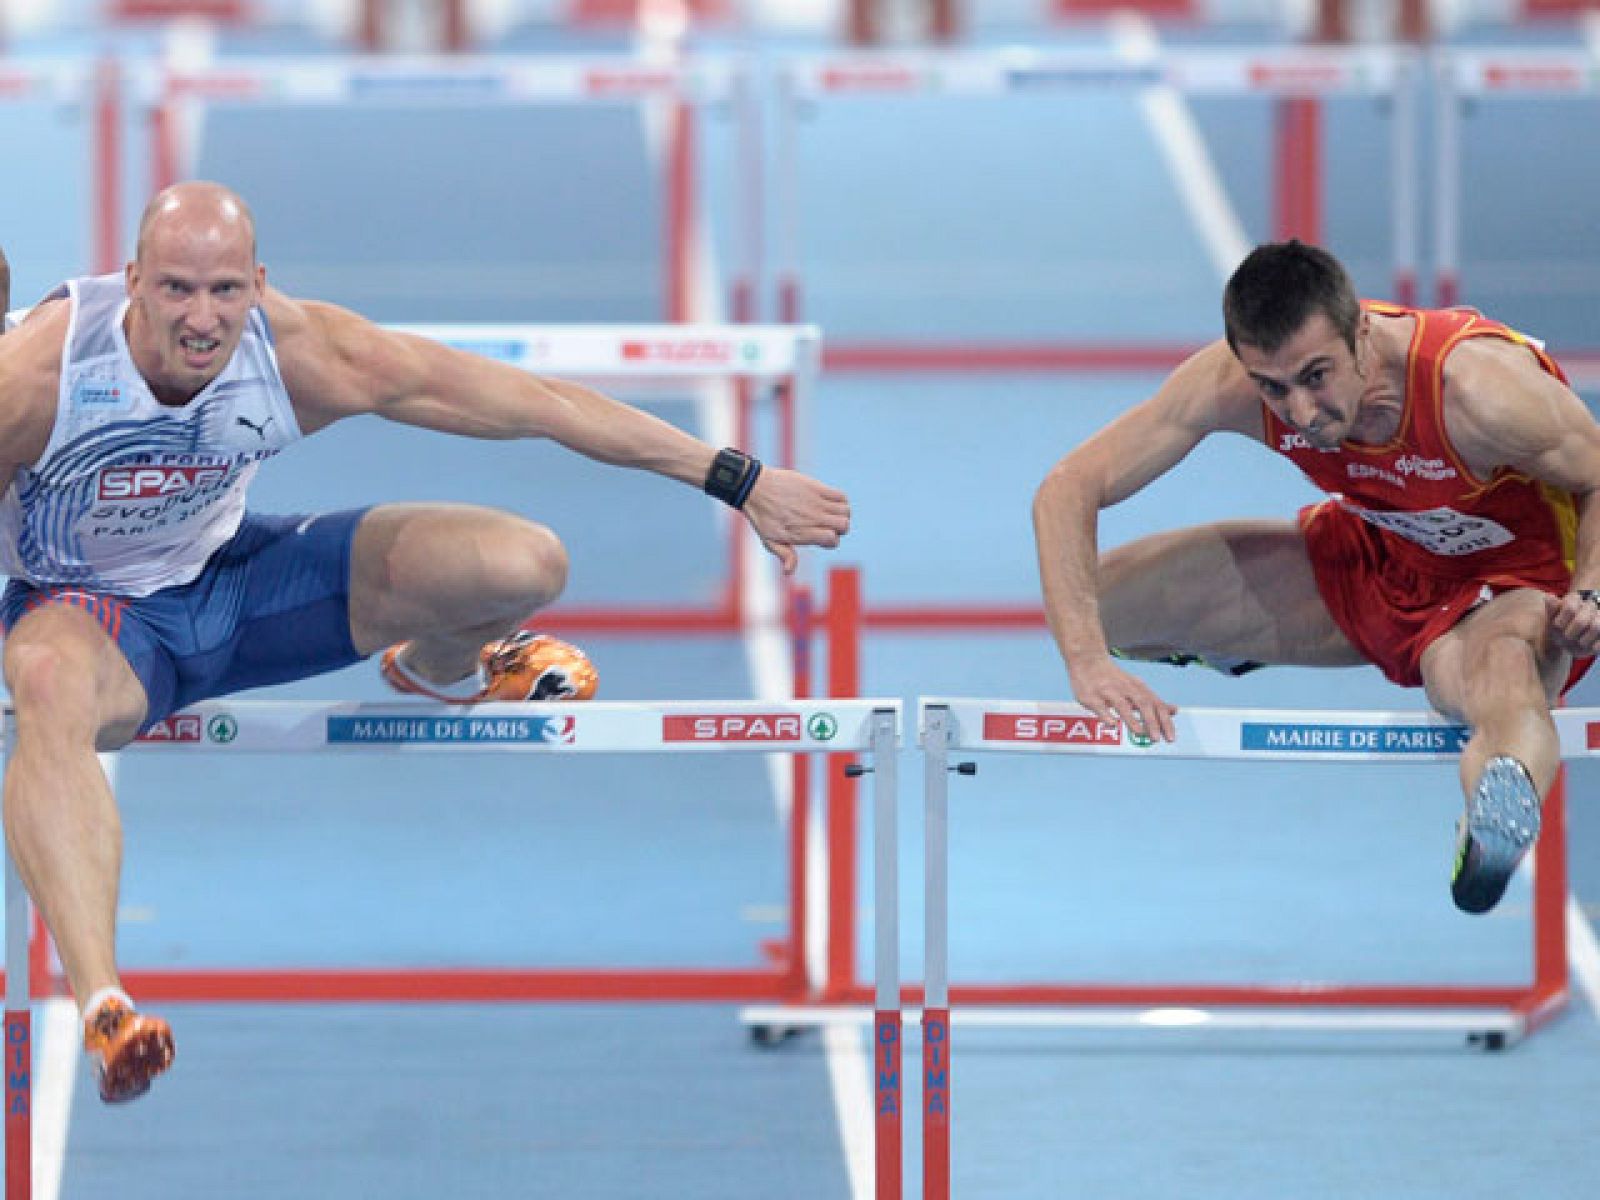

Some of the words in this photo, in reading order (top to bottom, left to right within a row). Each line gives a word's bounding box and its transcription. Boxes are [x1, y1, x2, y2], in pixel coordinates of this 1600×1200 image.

[146, 719, 200, 740] AR
[352, 719, 428, 739] MAIRIE
[434, 720, 464, 739] DE
[469, 720, 529, 739] PARIS
[693, 717, 801, 739] SPAR
[1014, 718, 1121, 742] SPAR
[1266, 728, 1344, 748] MAIRIE
[1349, 730, 1379, 749] DE
[1384, 731, 1446, 749] PARIS
[8, 1022, 29, 1115] DIMA
[878, 1022, 898, 1116] DIMA
[926, 1020, 946, 1114] DIMA
